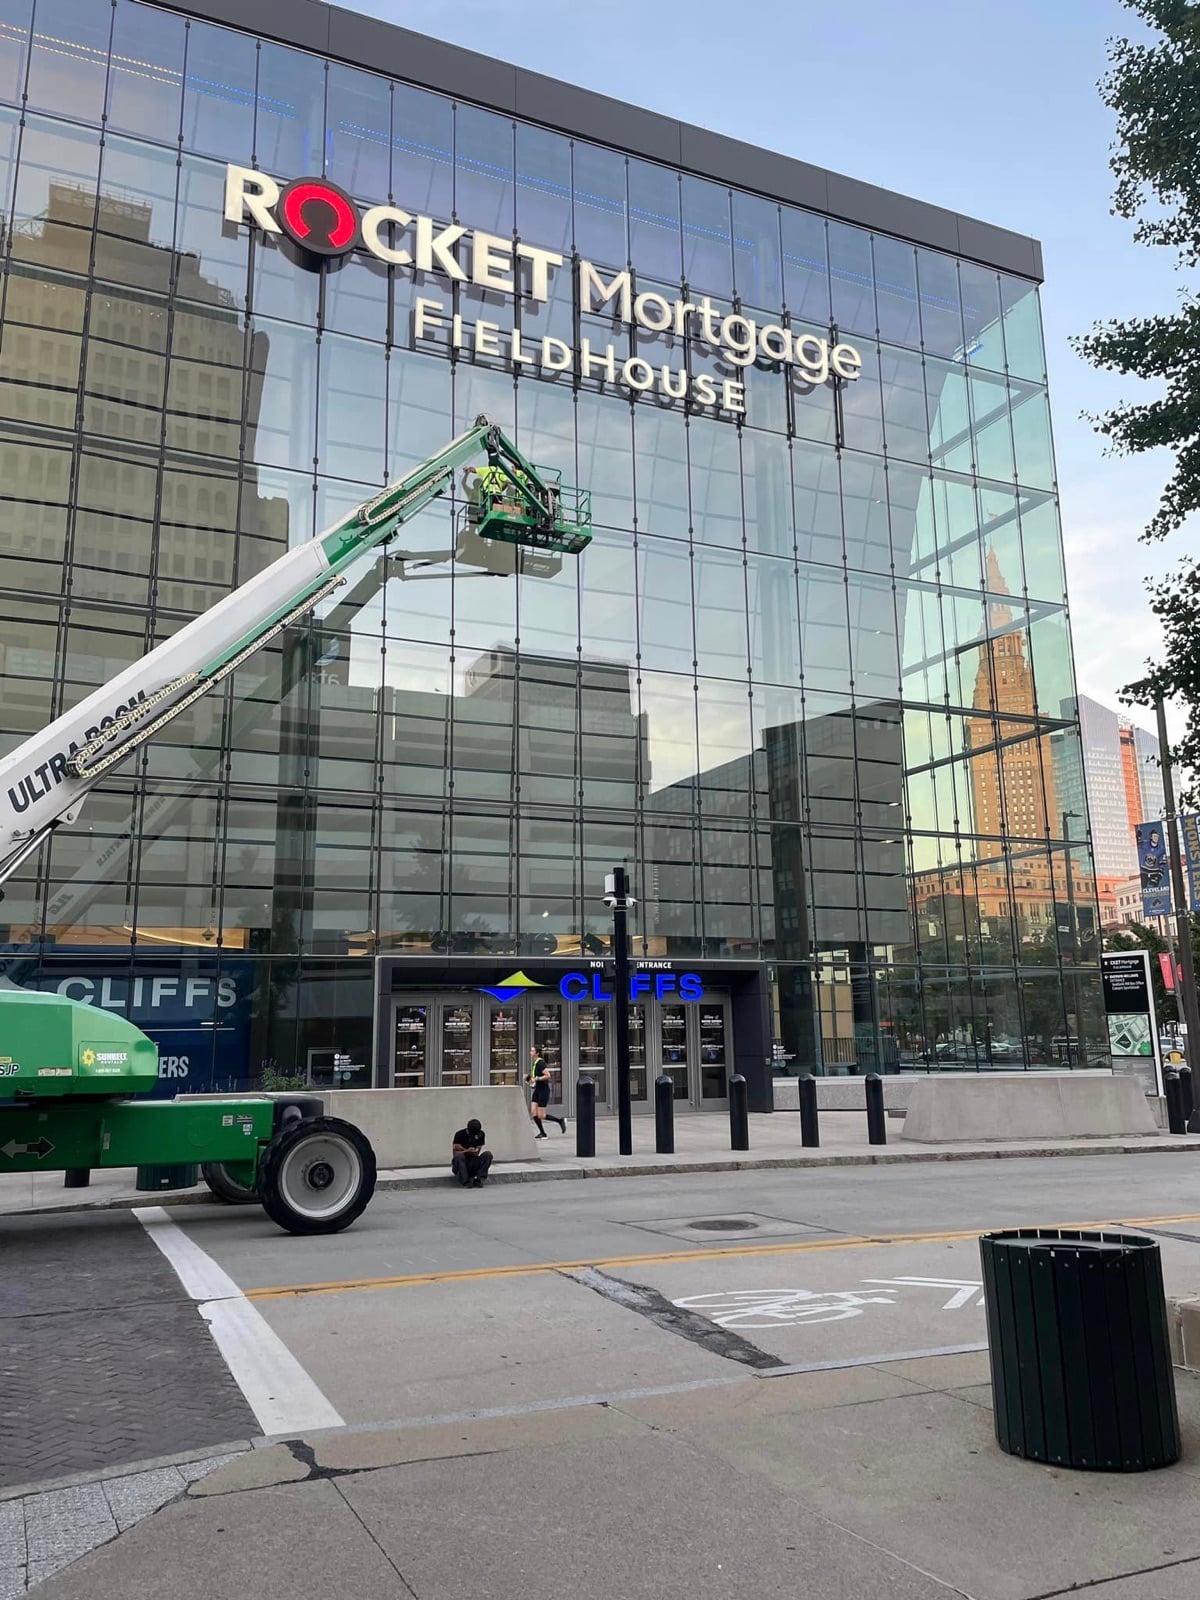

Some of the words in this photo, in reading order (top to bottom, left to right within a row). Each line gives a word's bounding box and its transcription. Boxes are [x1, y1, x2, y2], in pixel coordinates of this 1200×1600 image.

[225, 163, 563, 302] ROCKET
[580, 260, 862, 385] Mortgage
[414, 297, 746, 414] FIELDHOUSE
[637, 961, 672, 969] ENTRANCE
[57, 976, 237, 1008] CLIFFS
[560, 972, 704, 1001] CLFFS
